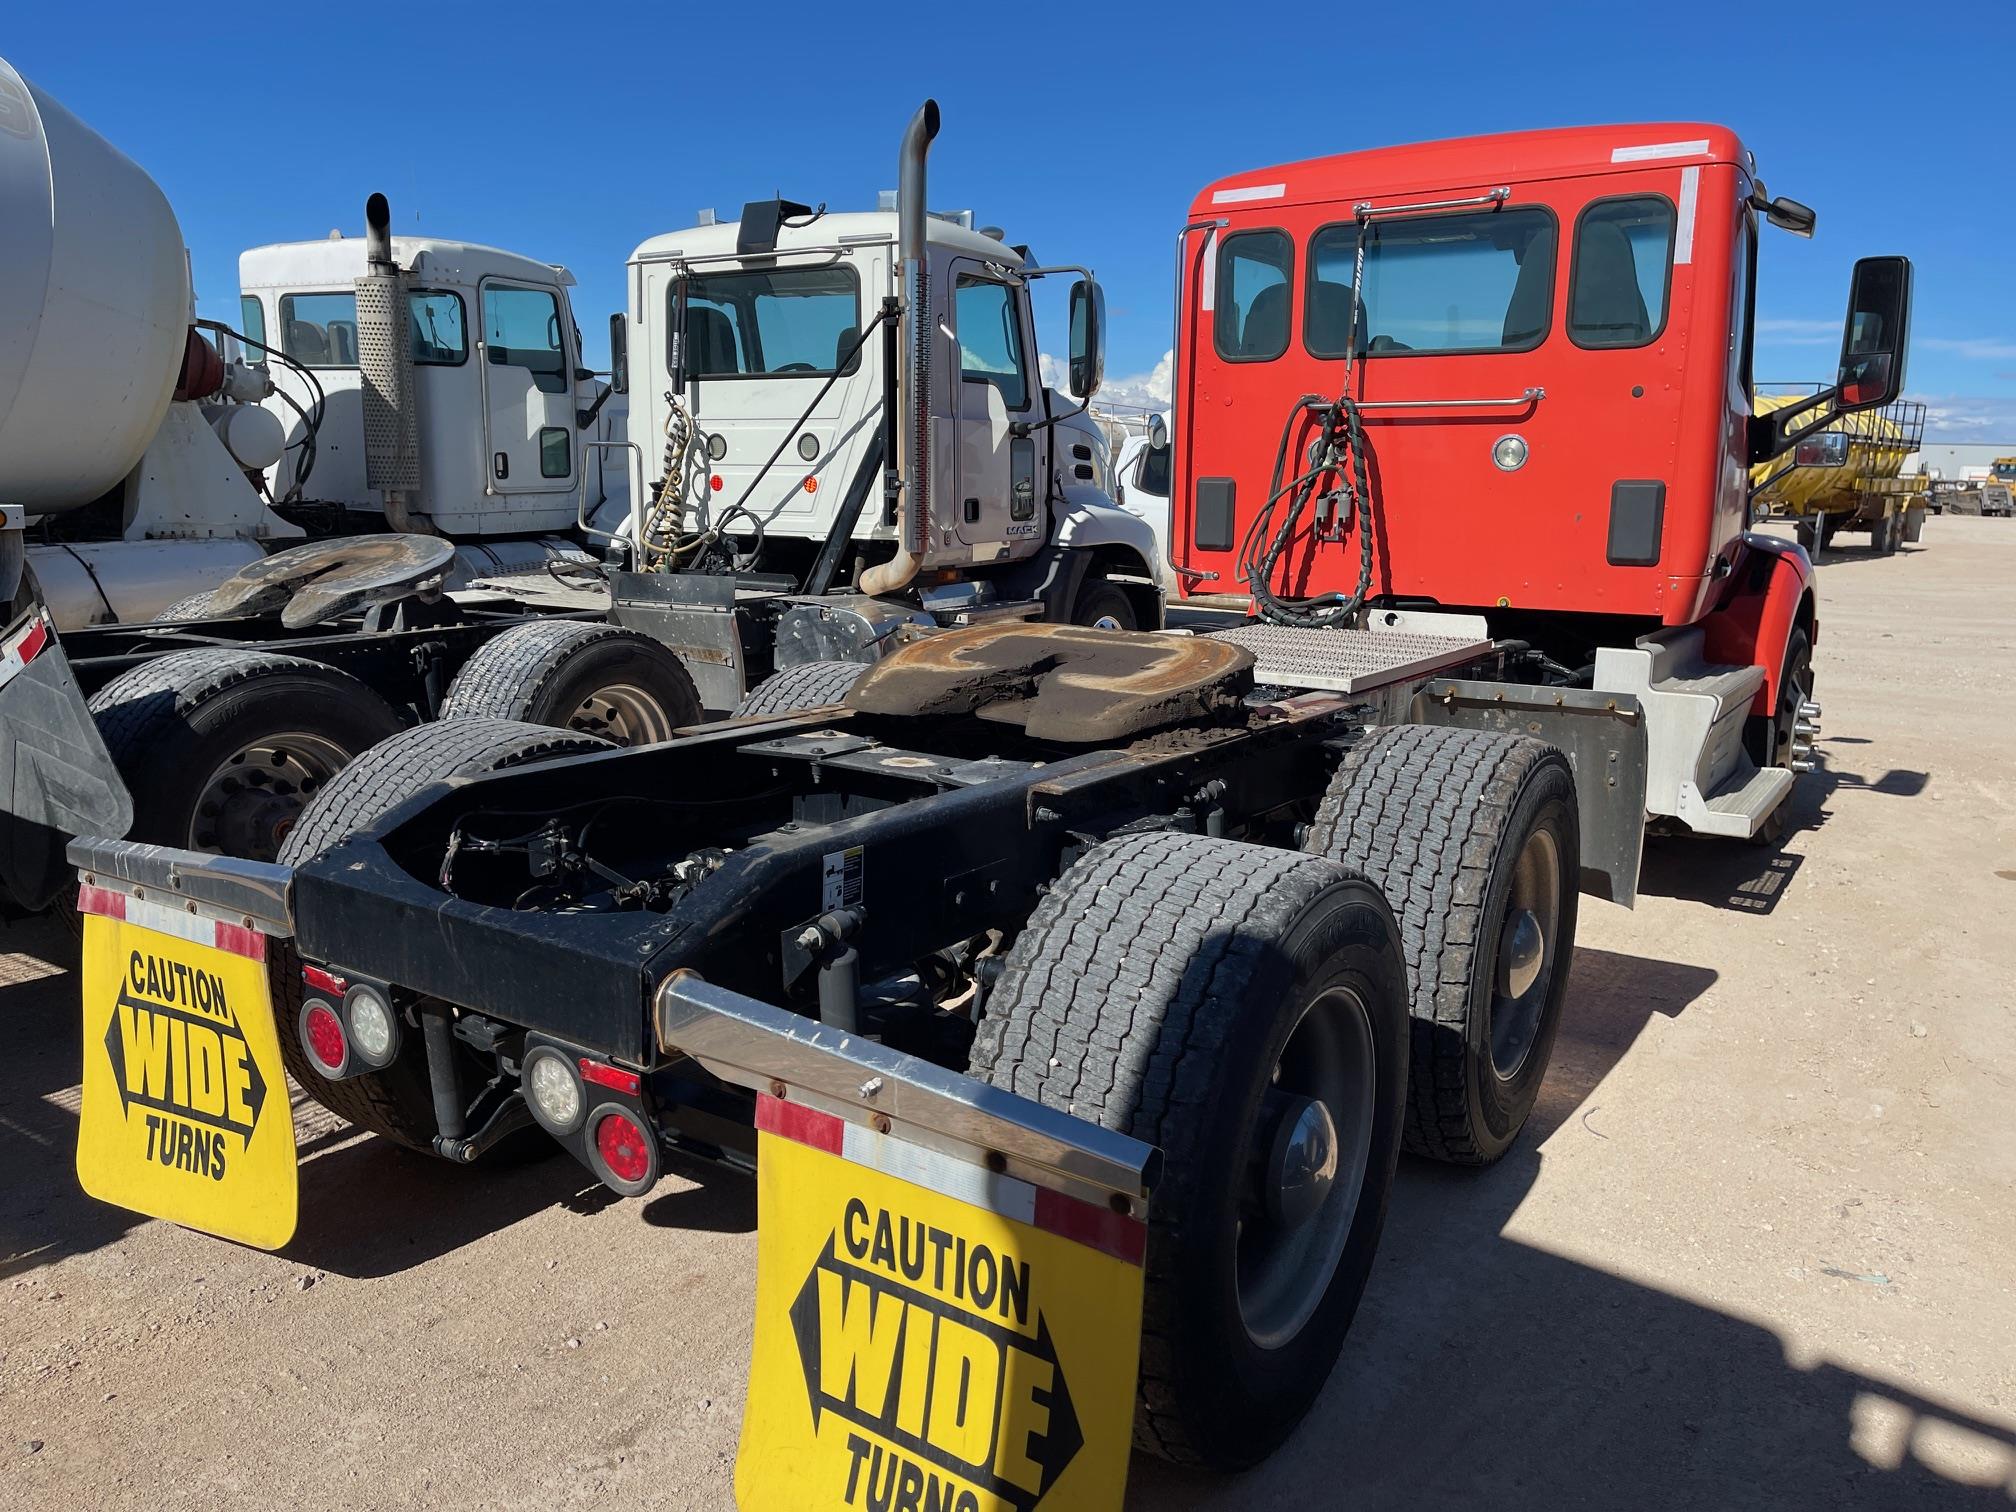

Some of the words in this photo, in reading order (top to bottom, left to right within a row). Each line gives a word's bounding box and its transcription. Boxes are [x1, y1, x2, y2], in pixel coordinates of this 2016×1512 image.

[1007, 526, 1038, 535] MACK
[130, 950, 228, 1019] CAUTION
[118, 1004, 253, 1127] WIDE
[146, 1114, 226, 1181] TURNS
[844, 1198, 1030, 1326] CAUTION
[817, 1267, 1054, 1496] WIDE
